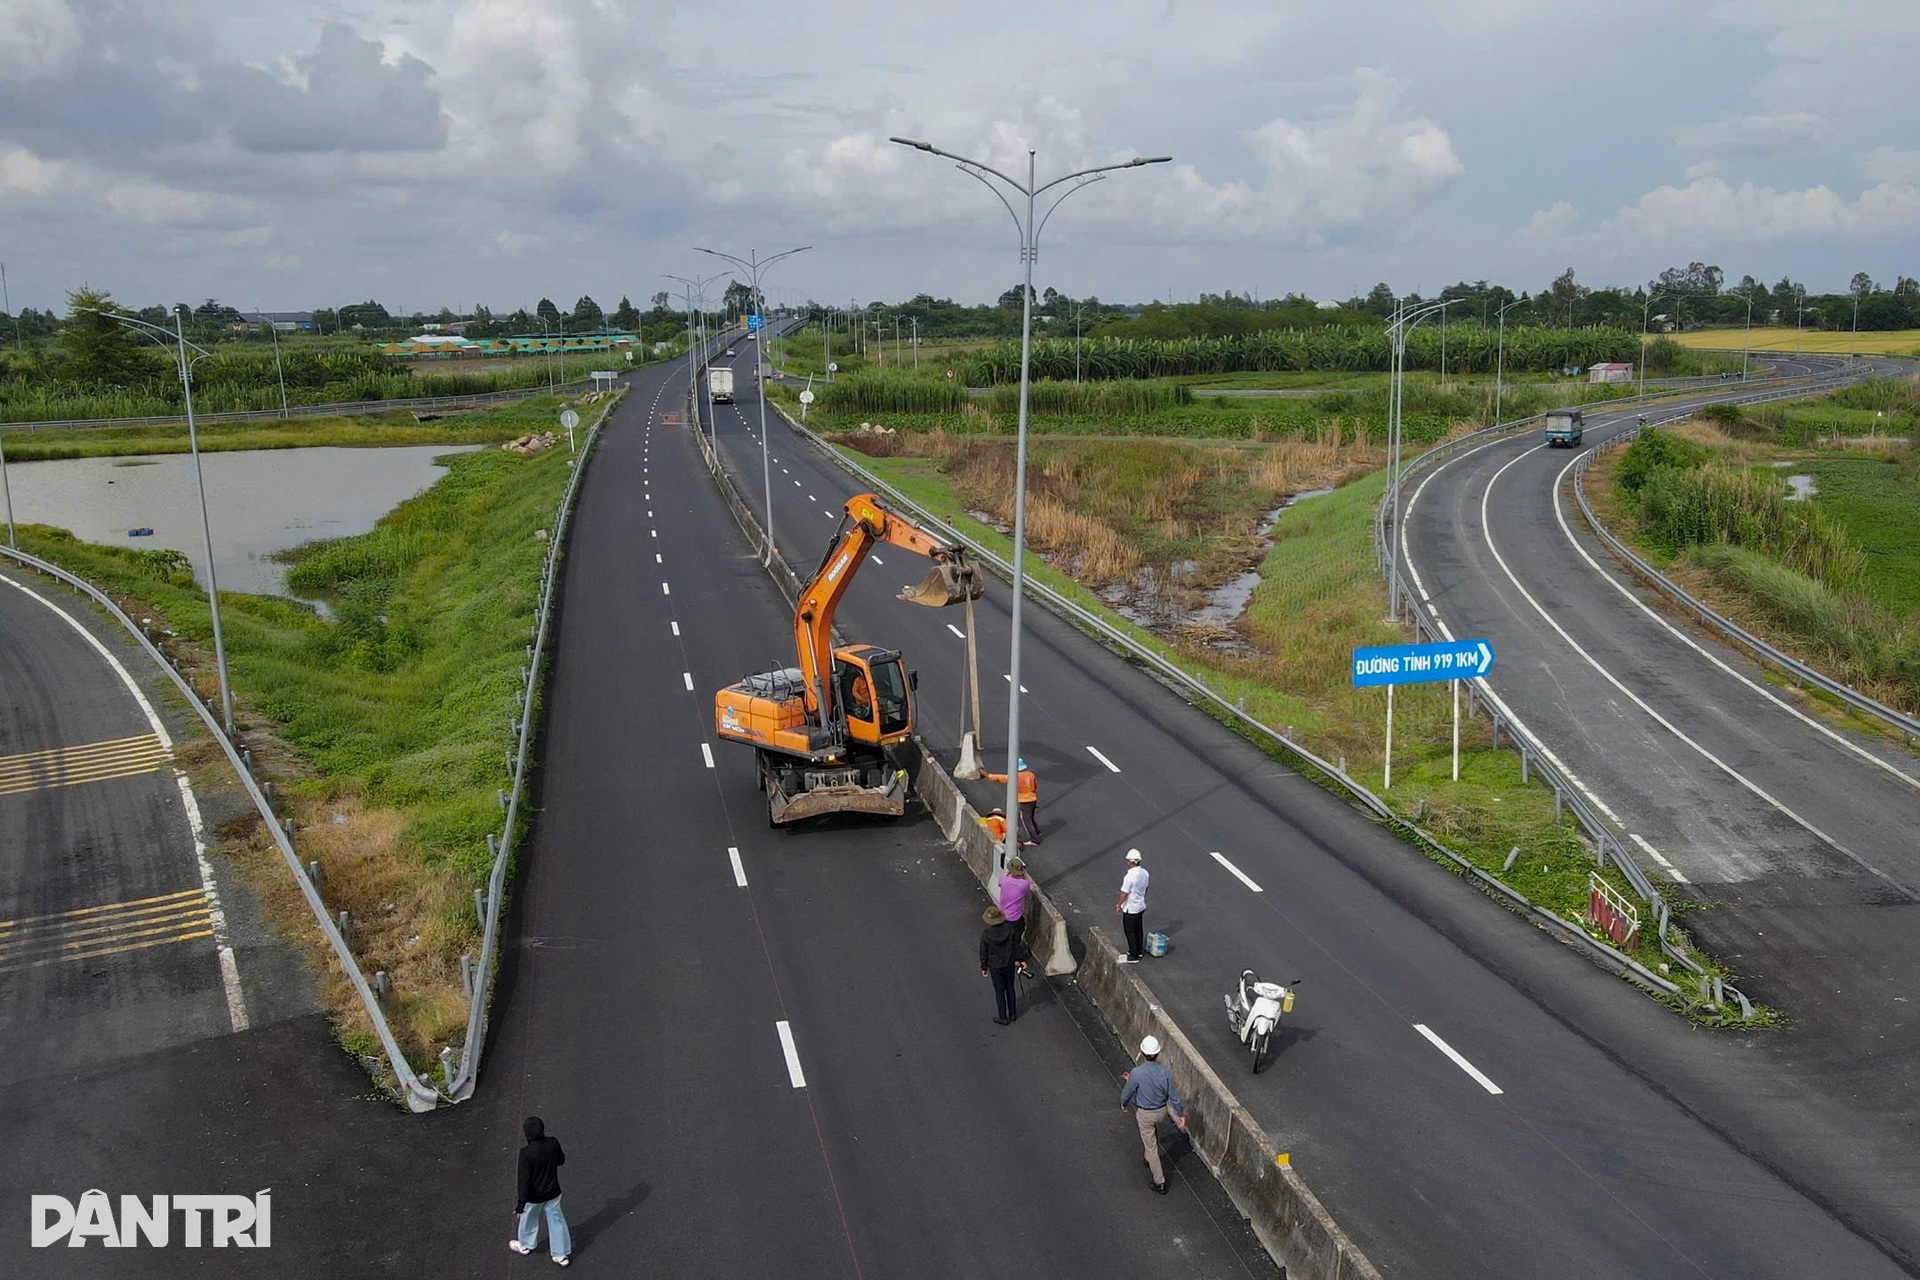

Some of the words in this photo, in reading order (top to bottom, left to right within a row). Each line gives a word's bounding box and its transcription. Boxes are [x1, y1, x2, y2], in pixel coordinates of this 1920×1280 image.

[1356, 655, 1400, 675] ĐƯỜNG
[1403, 652, 1431, 671] TỈNH
[1434, 653, 1453, 669] 919
[1455, 651, 1478, 668] 1KM
